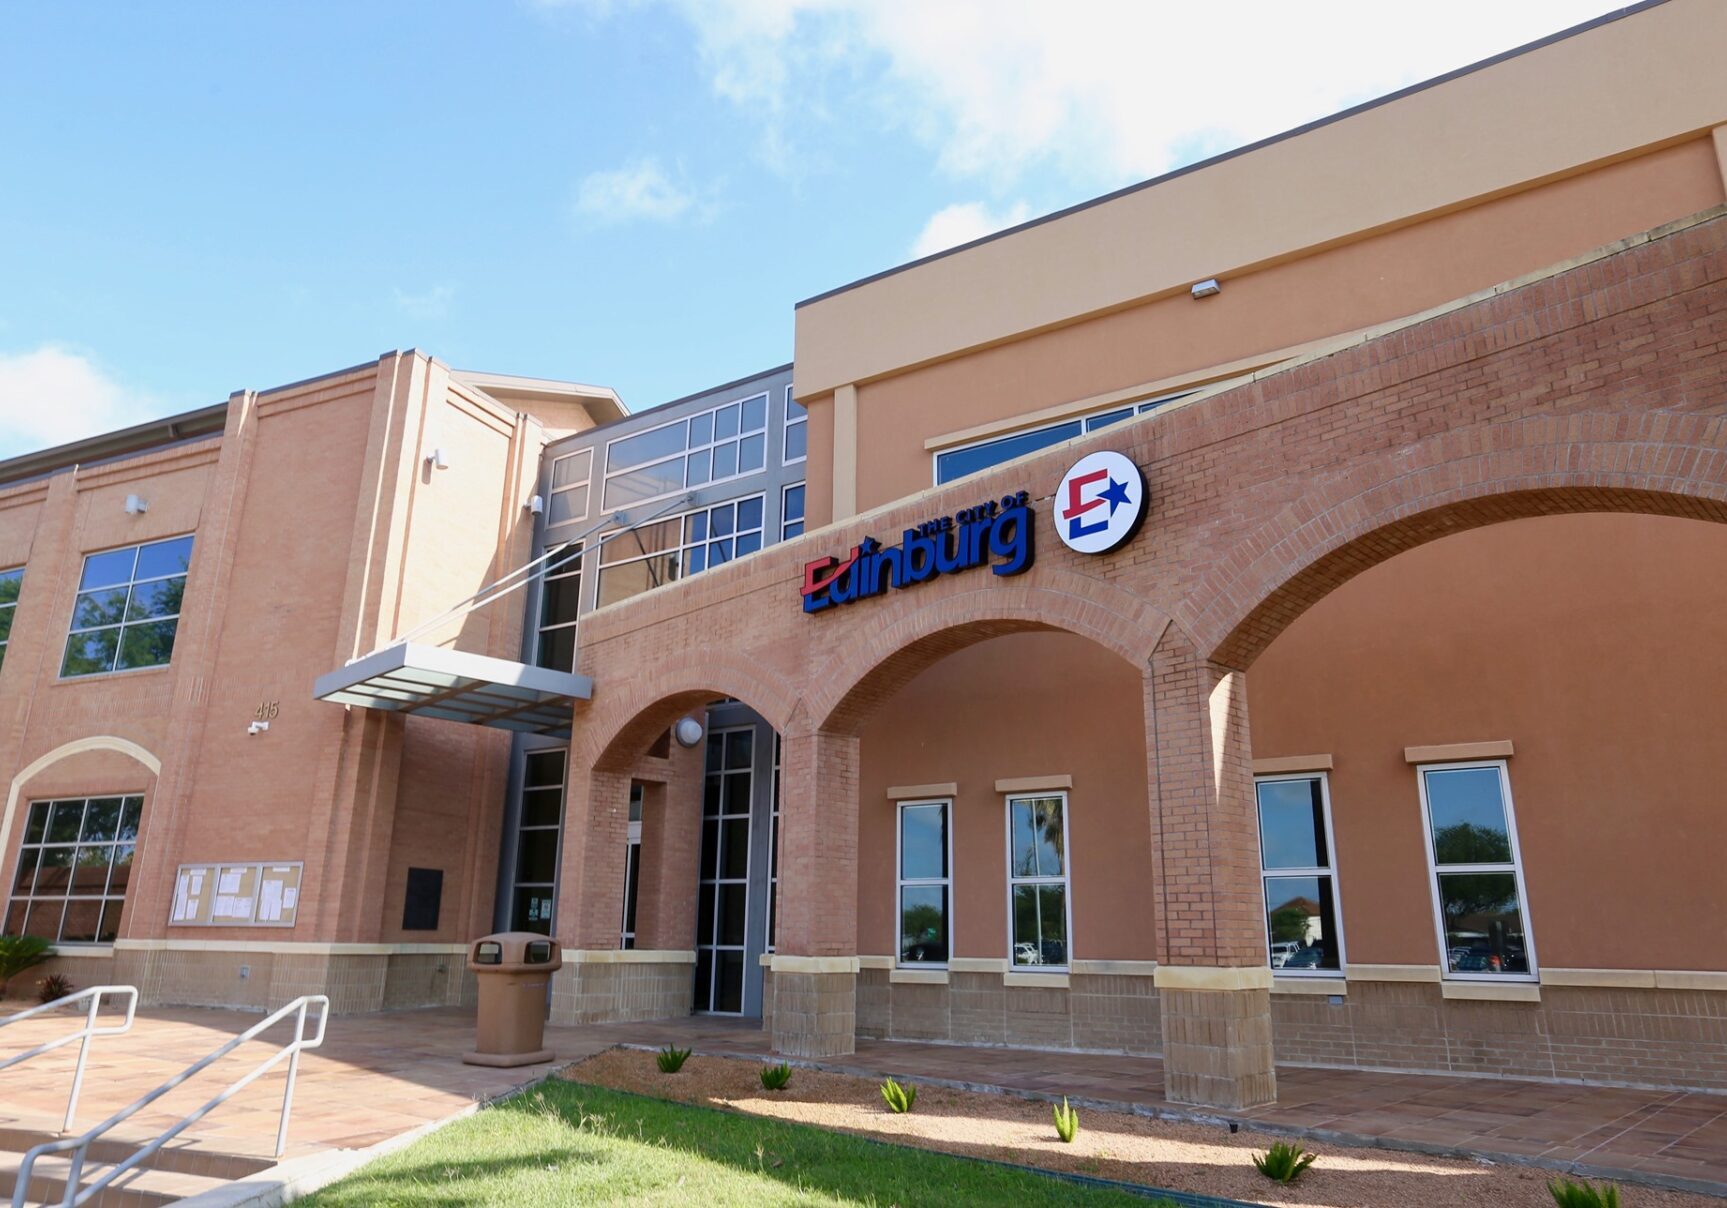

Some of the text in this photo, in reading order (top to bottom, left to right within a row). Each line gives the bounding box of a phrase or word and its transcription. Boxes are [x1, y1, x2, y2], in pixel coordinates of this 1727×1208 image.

[917, 490, 1029, 536] THE CITY OF
[800, 506, 1034, 613] Edinburg
[255, 701, 280, 720] 415
